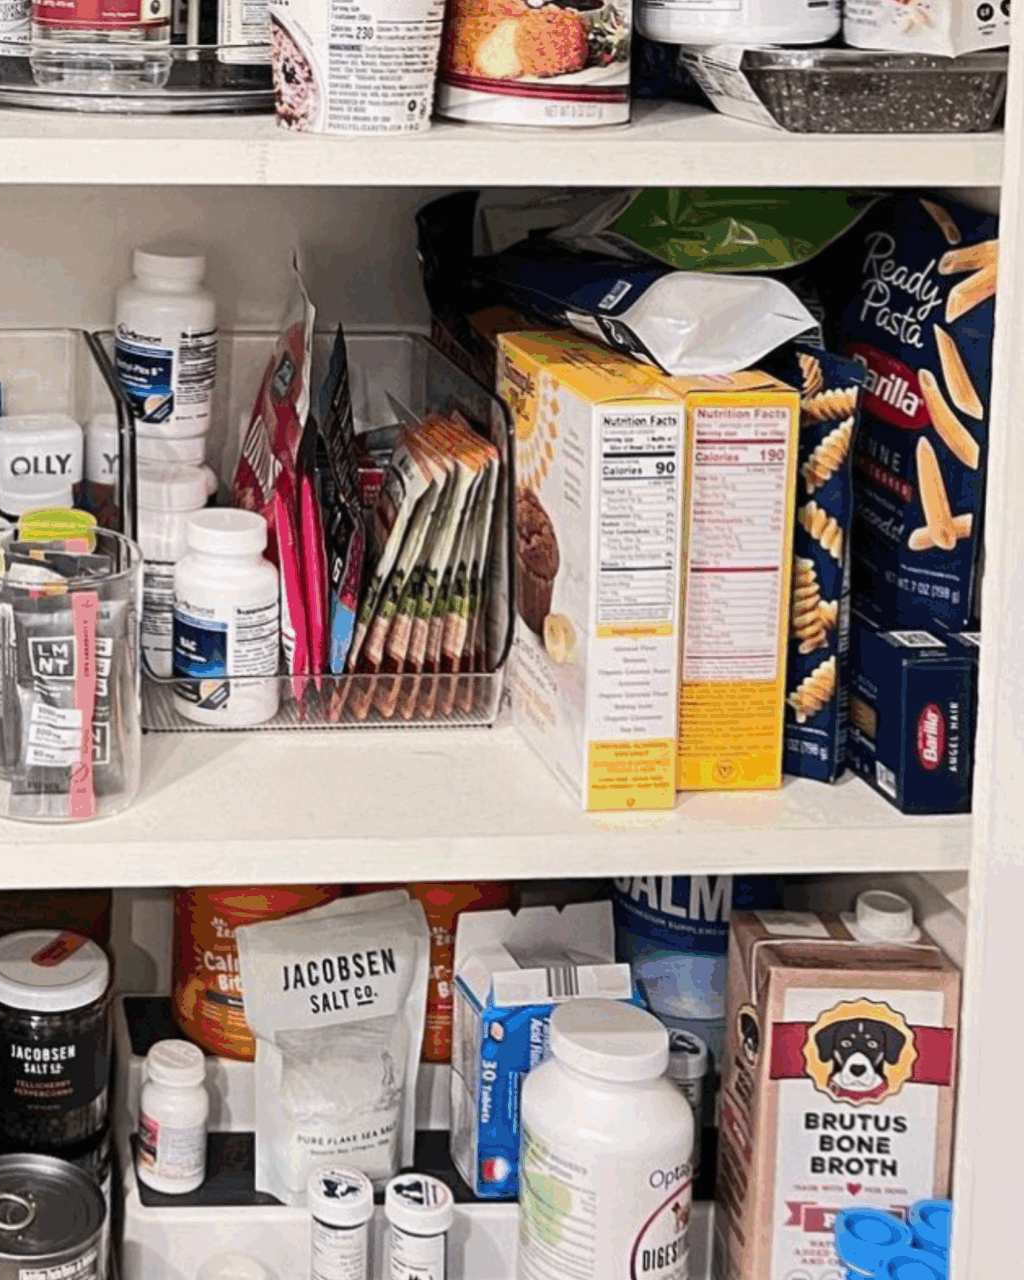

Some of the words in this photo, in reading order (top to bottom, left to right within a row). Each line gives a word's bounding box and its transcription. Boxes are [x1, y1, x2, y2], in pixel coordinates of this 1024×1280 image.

[356, 25, 375, 41] 230
[862, 231, 942, 320] Ready
[860, 278, 924, 349] Pasta
[603, 416, 647, 427] Nutrition
[649, 415, 677, 427] Facts
[697, 409, 751, 420] Nutrition
[754, 409, 788, 420] Facts
[10, 453, 73, 477] OLLY
[695, 451, 740, 463] Calories
[759, 448, 785, 462] 190
[602, 465, 643, 476] Calories
[655, 461, 676, 475] 90
[949, 702, 959, 731] HAIR
[948, 735, 959, 773] ANGEL
[282, 947, 397, 991] JACOBSEN
[309, 988, 351, 1015] SALT
[354, 984, 379, 1006] CO.
[11, 1044, 76, 1062] JACOBSEN
[23, 1062, 48, 1075] SALT
[482, 1060, 498, 1082] 30
[480, 1084, 493, 1124] Tablets
[804, 1112, 908, 1133] BRUTUS
[297, 1134, 324, 1146] PURE
[327, 1133, 358, 1146] FLAKE
[361, 1129, 378, 1140] SEA
[818, 1134, 892, 1155] BONE
[810, 1155, 898, 1178] BROTH
